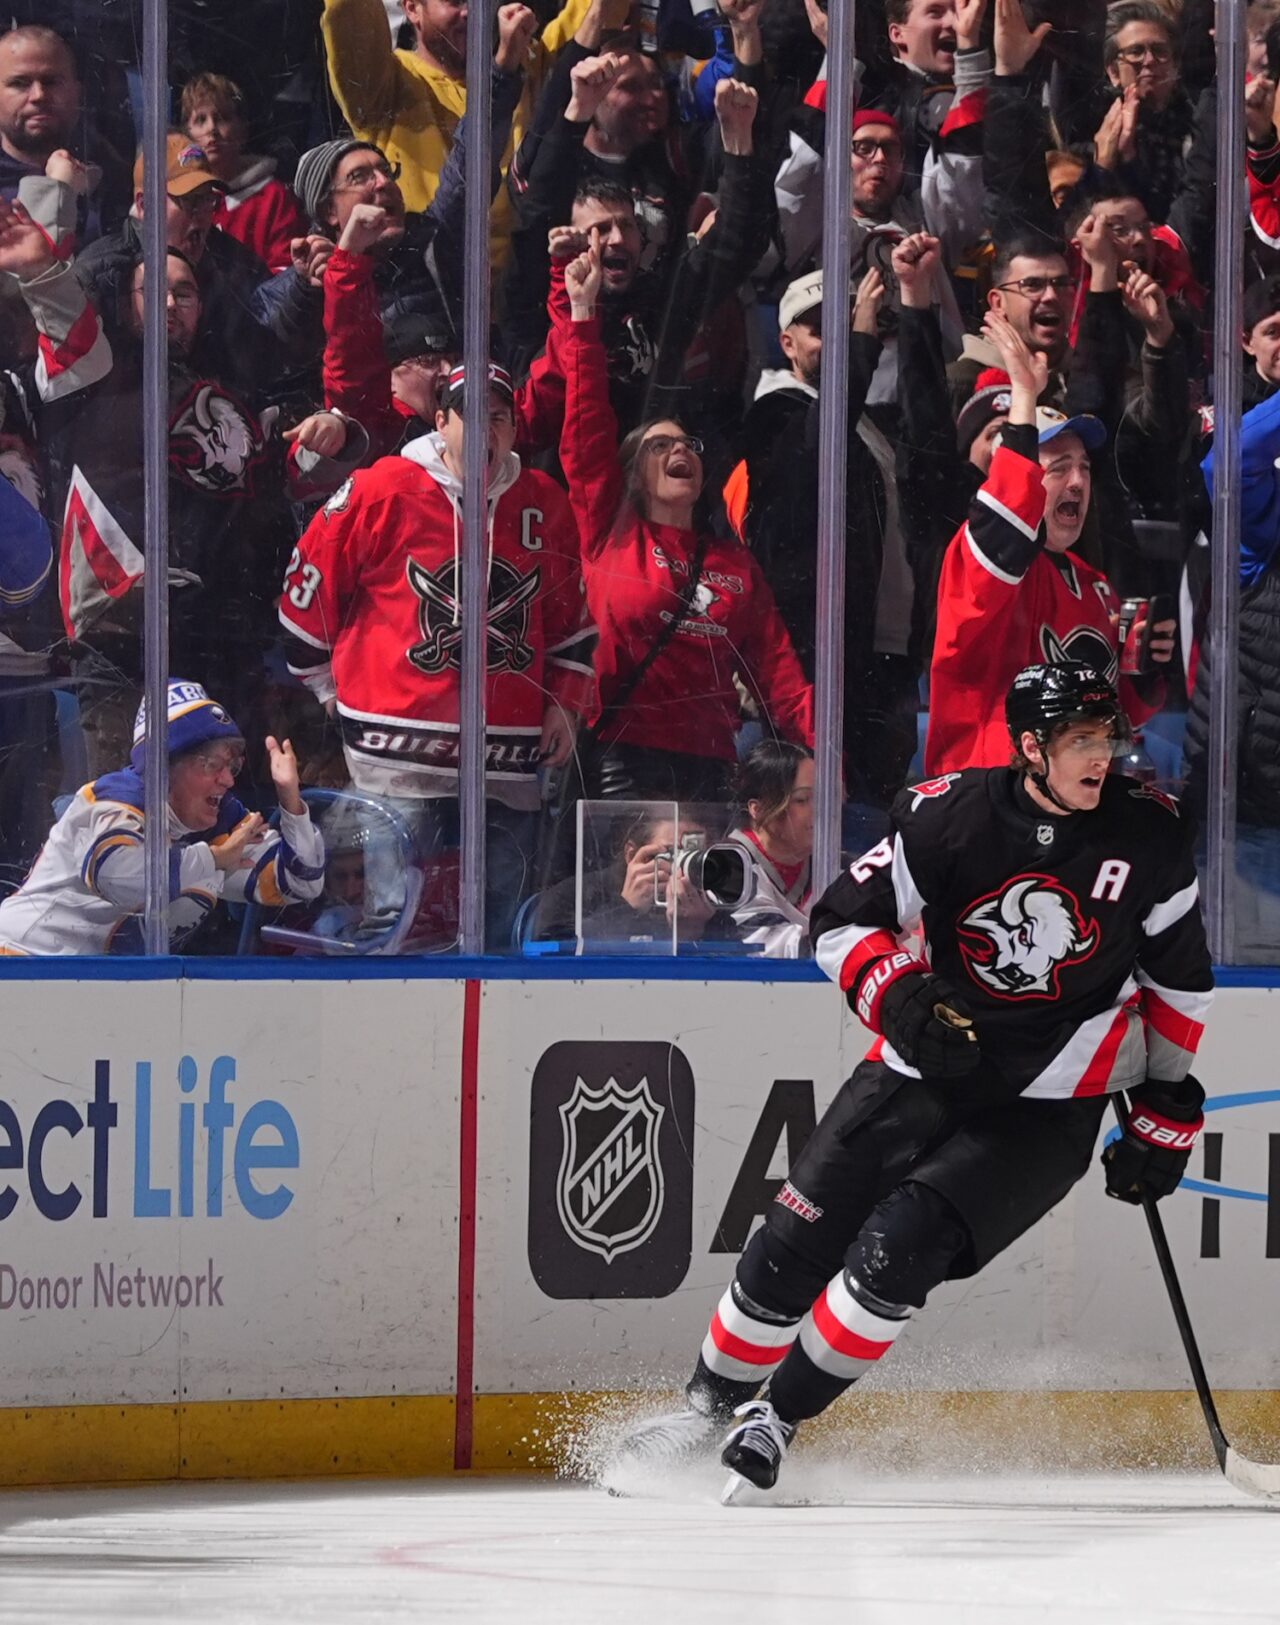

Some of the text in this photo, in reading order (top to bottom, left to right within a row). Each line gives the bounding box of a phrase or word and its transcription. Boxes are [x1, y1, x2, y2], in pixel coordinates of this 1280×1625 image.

[522, 508, 543, 550] C
[850, 837, 893, 884] 2
[1092, 859, 1132, 902] A
[581, 1125, 642, 1220] NHL
[0, 1257, 224, 1310] Donor Network
